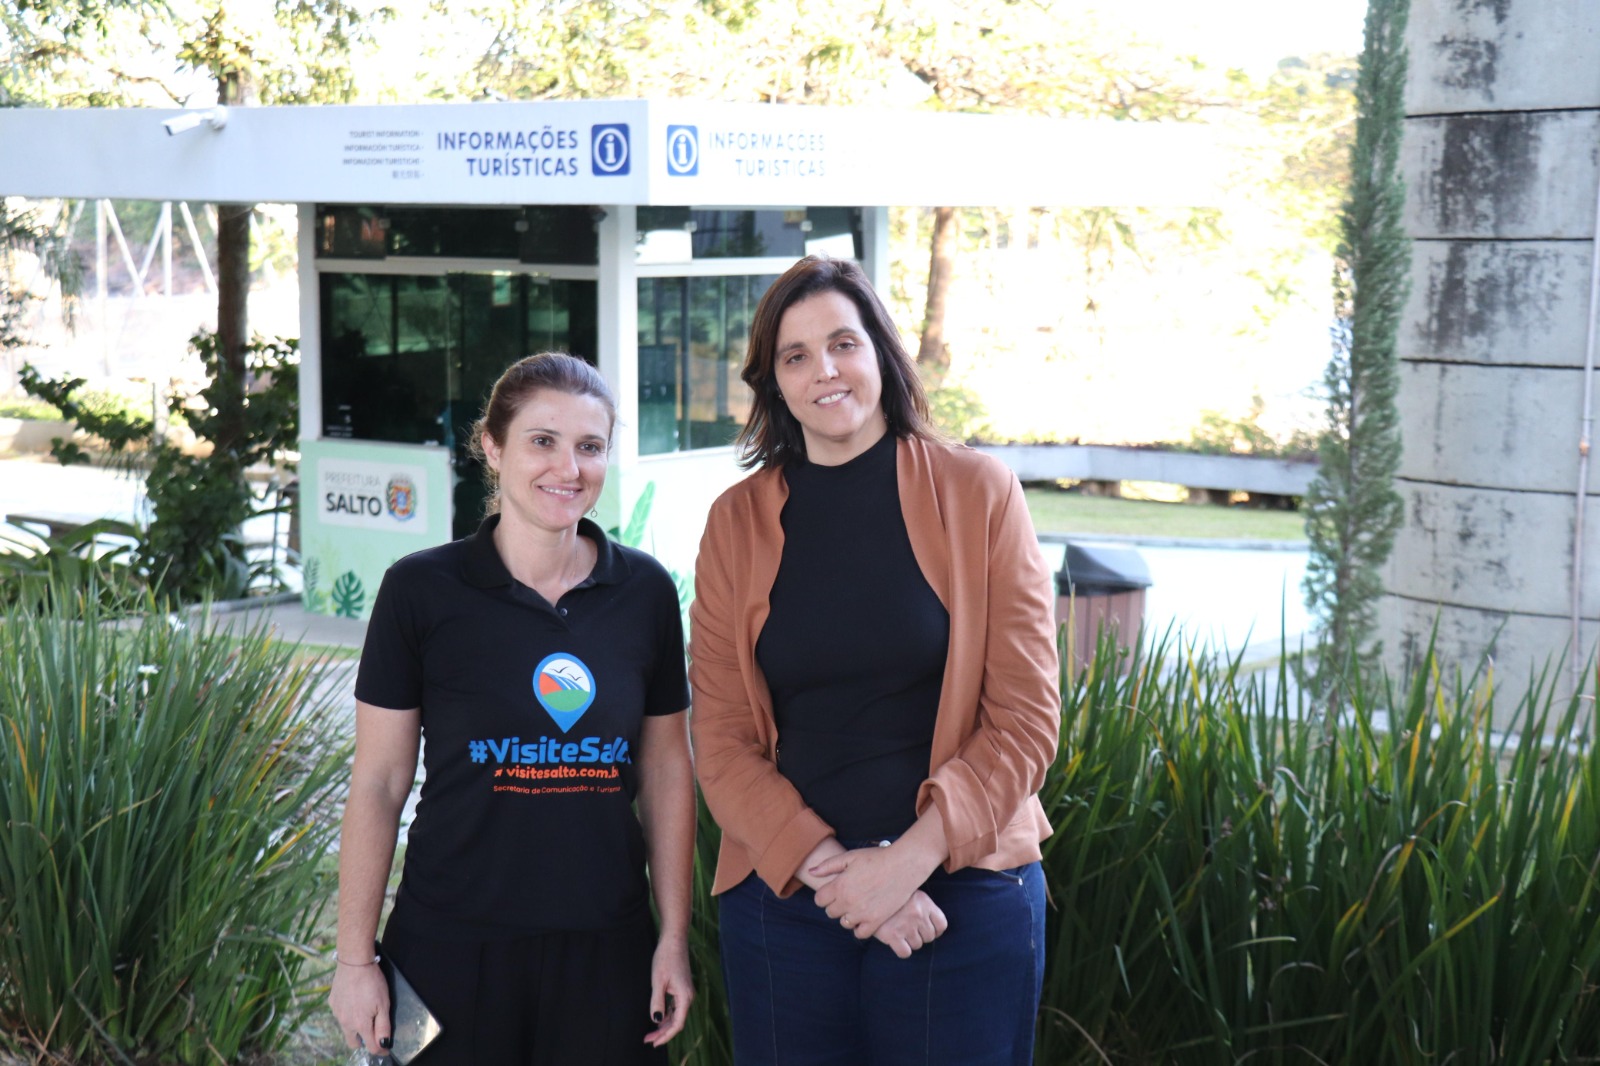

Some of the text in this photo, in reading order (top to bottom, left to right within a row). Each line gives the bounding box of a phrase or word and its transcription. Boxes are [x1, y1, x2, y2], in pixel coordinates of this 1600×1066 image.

[437, 125, 578, 153] INFORMAÇÕES
[466, 152, 578, 176] TURÍSTICAS
[325, 471, 381, 487] PREFEITURA
[326, 491, 382, 517] SALTO
[468, 736, 631, 764] #VisiteSalt
[493, 785, 530, 795] Secretaria
[531, 786, 541, 795] de
[541, 784, 589, 794] Comunicação
